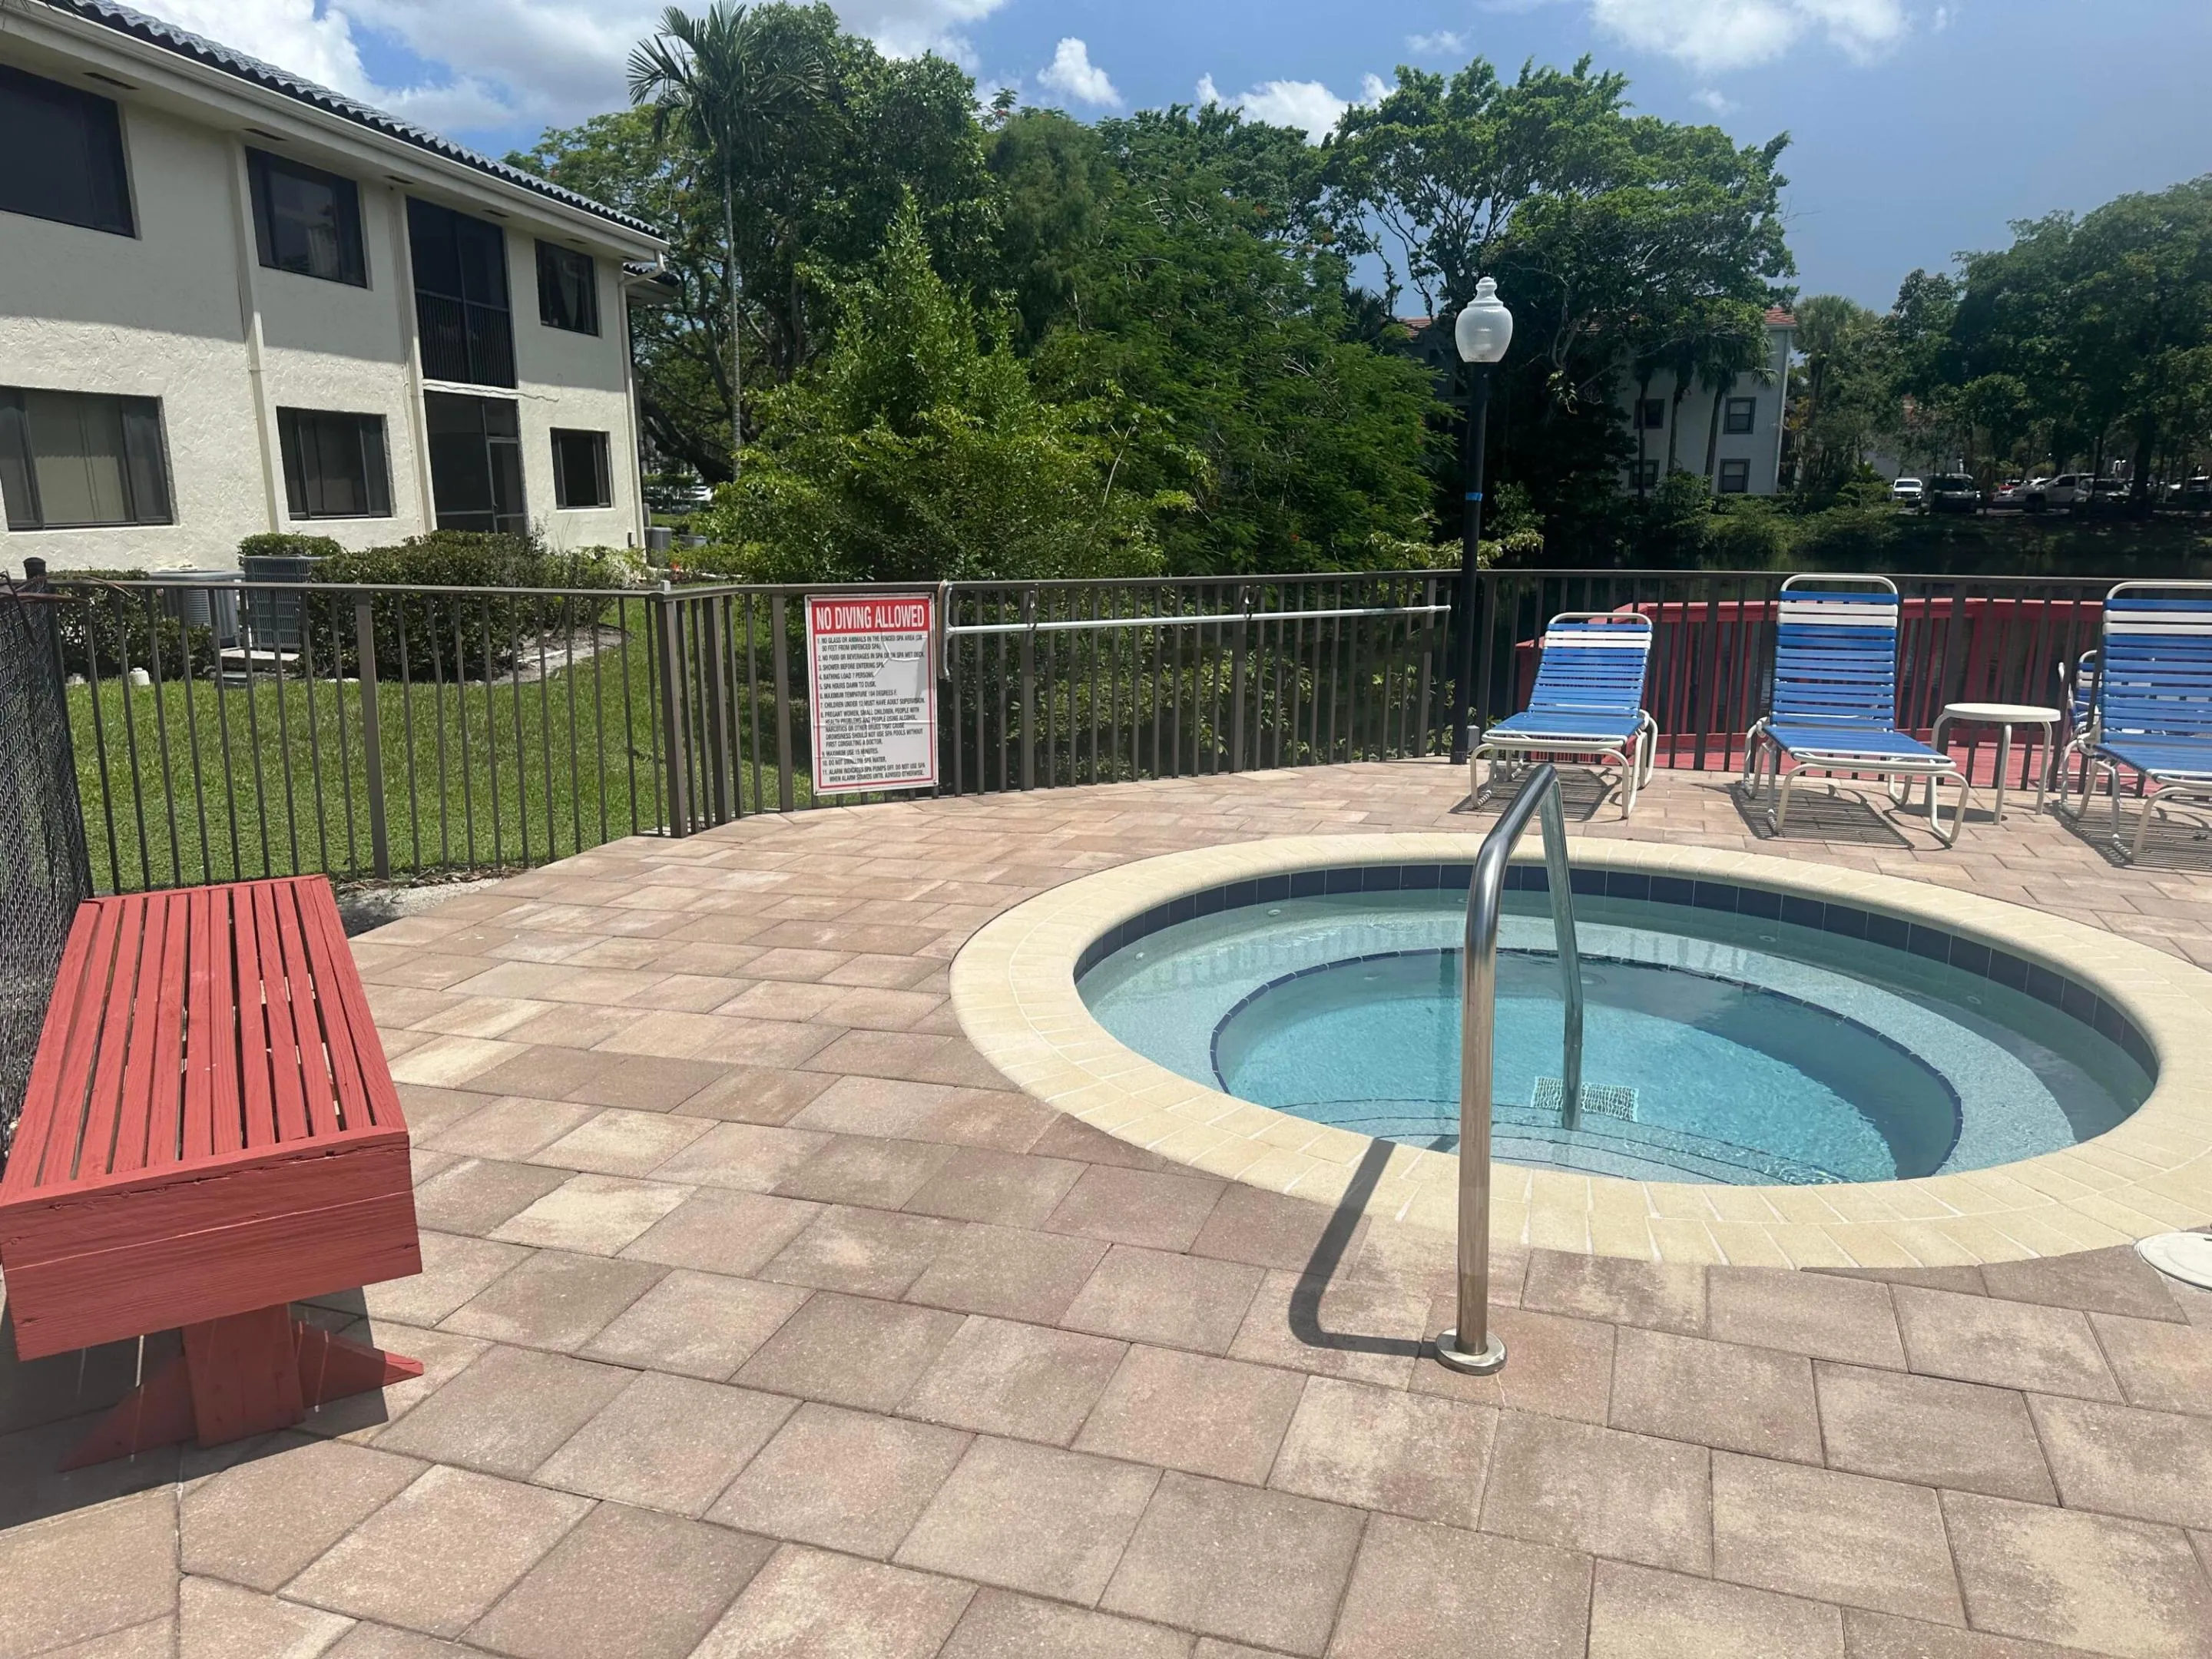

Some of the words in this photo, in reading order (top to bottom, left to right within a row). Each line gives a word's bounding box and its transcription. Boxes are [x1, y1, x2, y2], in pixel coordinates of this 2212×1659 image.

[816, 607, 832, 631] NO
[835, 606, 872, 630] DIVING
[875, 604, 925, 628] ALLOWED
